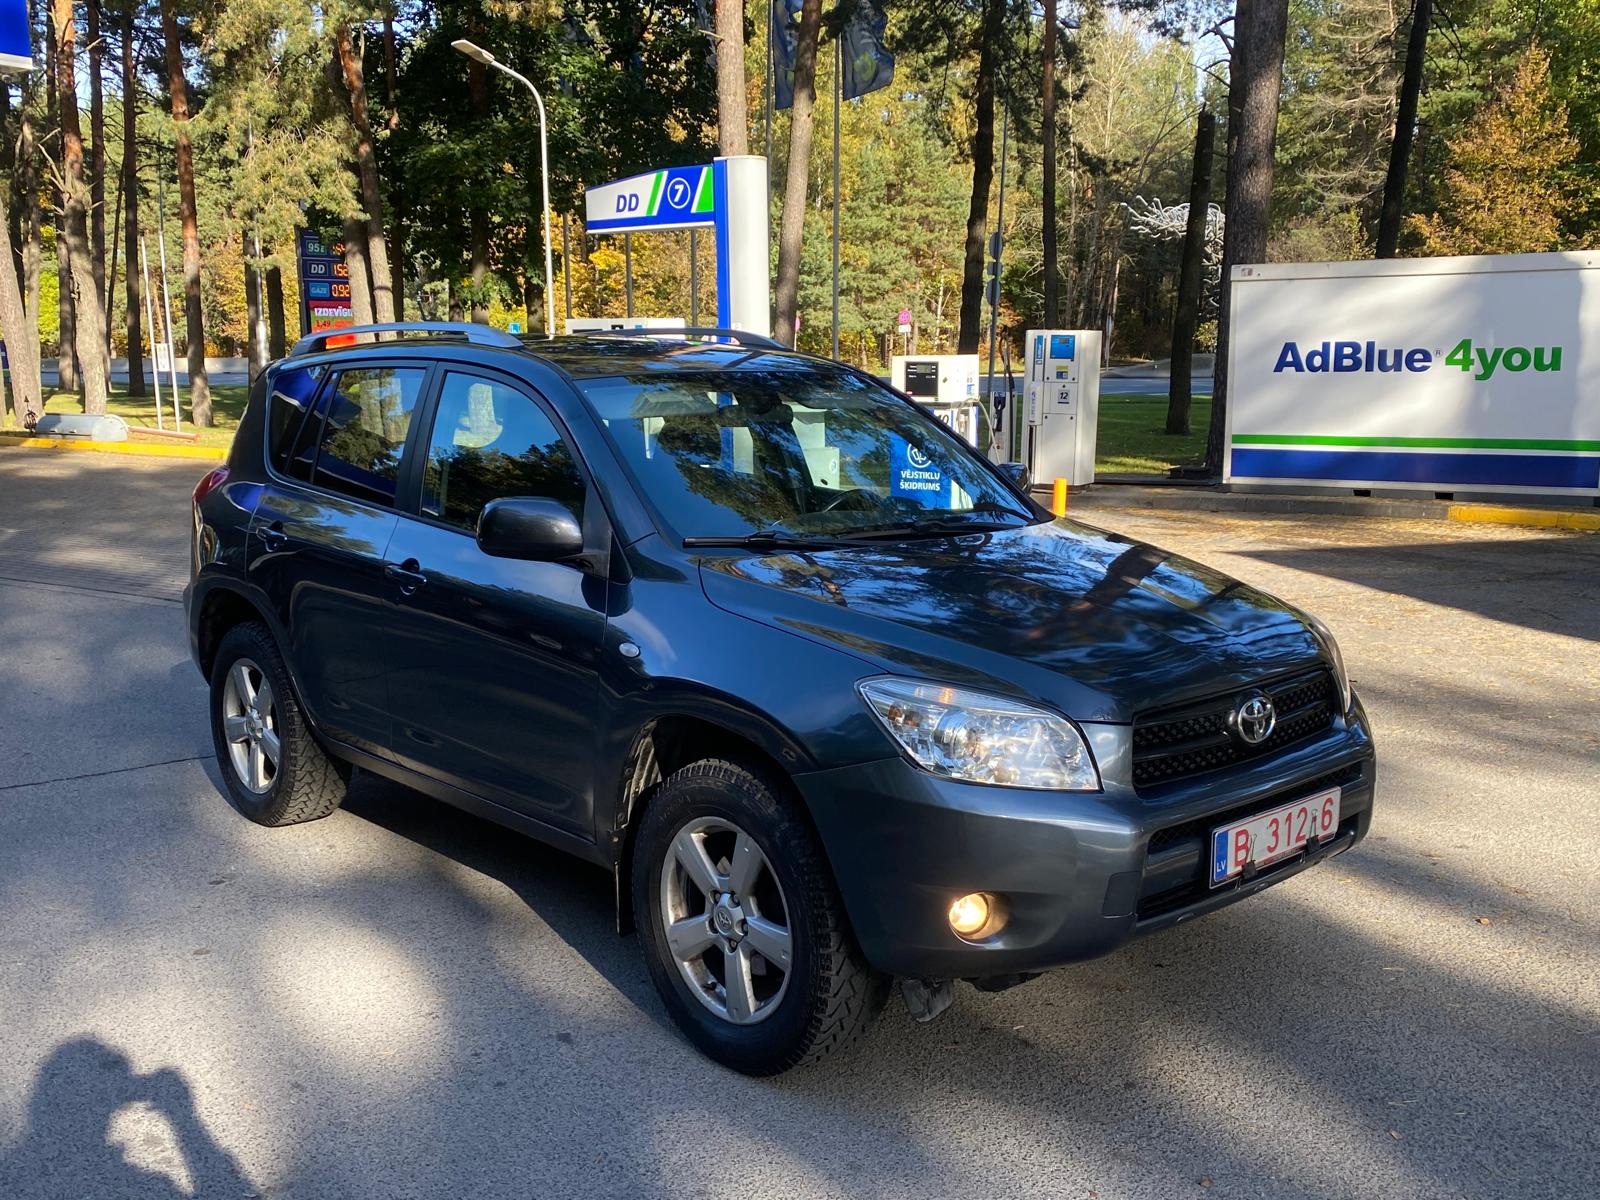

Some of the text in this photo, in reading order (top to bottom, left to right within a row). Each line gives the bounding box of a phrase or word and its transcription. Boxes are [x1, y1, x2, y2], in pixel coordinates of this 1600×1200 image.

[673, 185, 683, 203] 7
[616, 193, 640, 213] DD
[311, 264, 325, 274] DD
[1445, 338, 1562, 381] 4you
[1059, 392, 1069, 400] 12
[1216, 860, 1227, 872] LV
